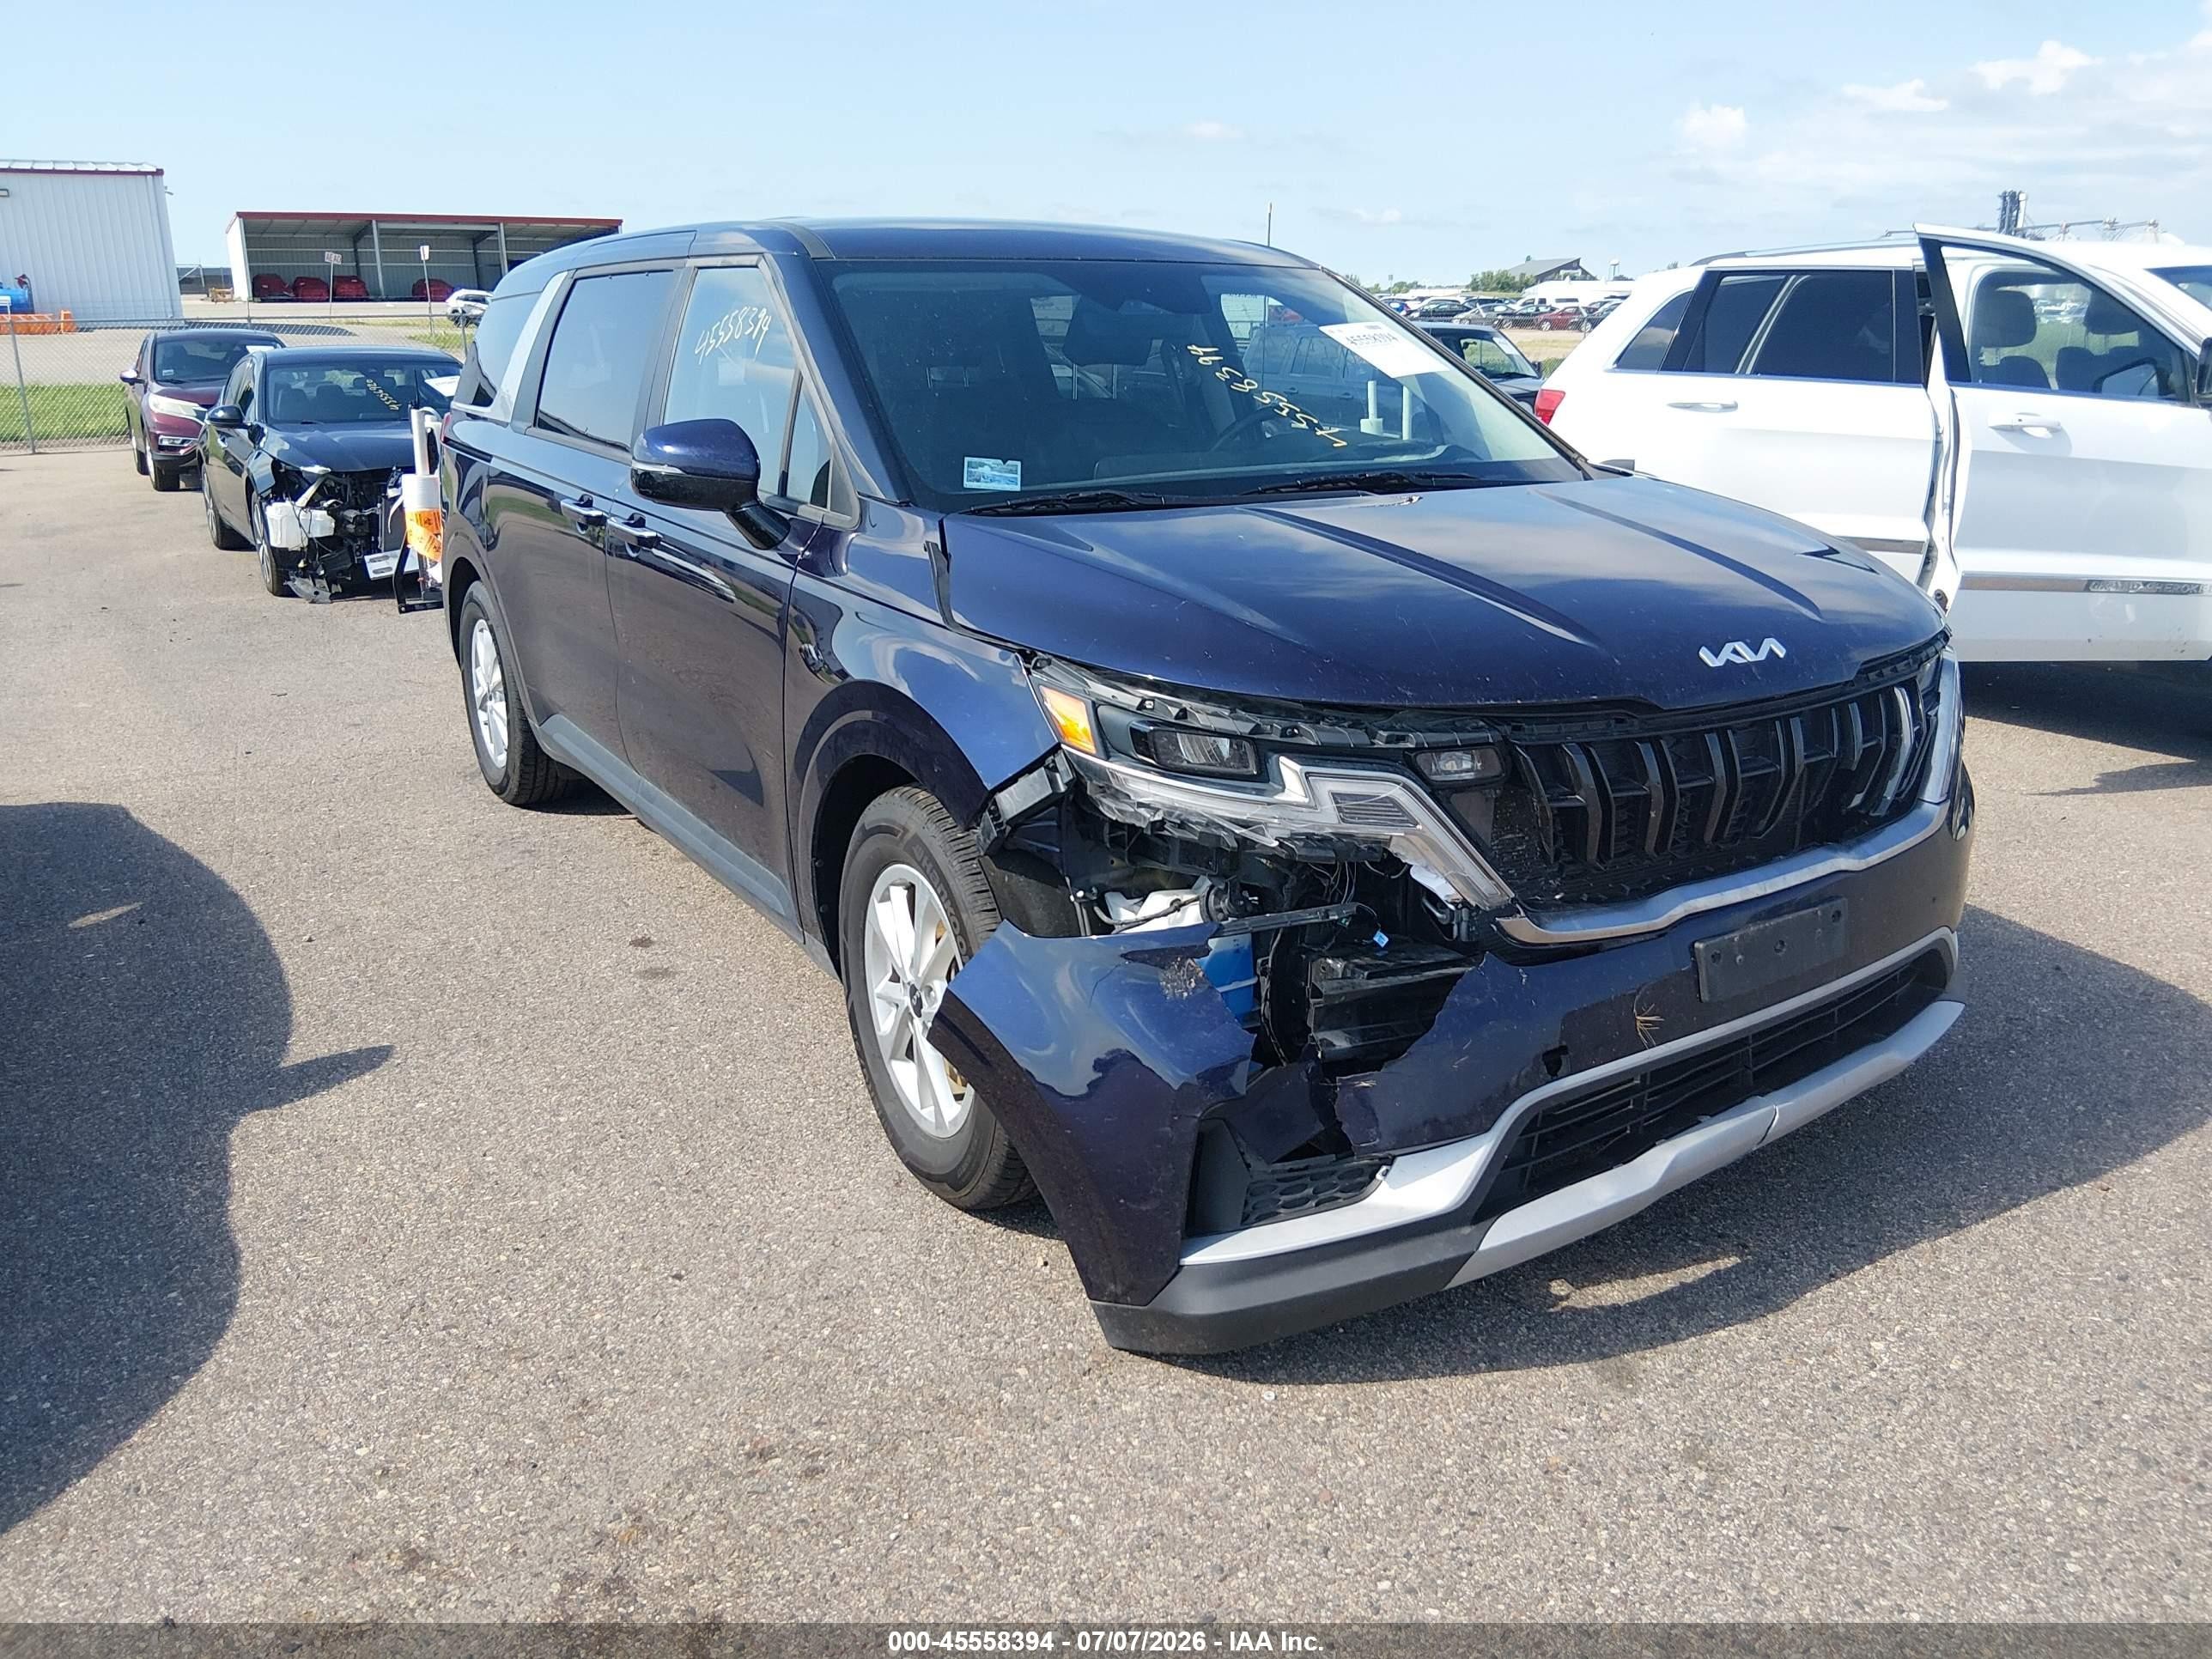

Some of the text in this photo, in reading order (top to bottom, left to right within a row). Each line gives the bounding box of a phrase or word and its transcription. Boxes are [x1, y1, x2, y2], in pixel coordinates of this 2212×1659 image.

[695, 306, 772, 365] 45558394
[1187, 343, 1348, 447] 45558394
[2146, 582, 2212, 595] CHEROKE
[1698, 637, 1787, 667] KIA
